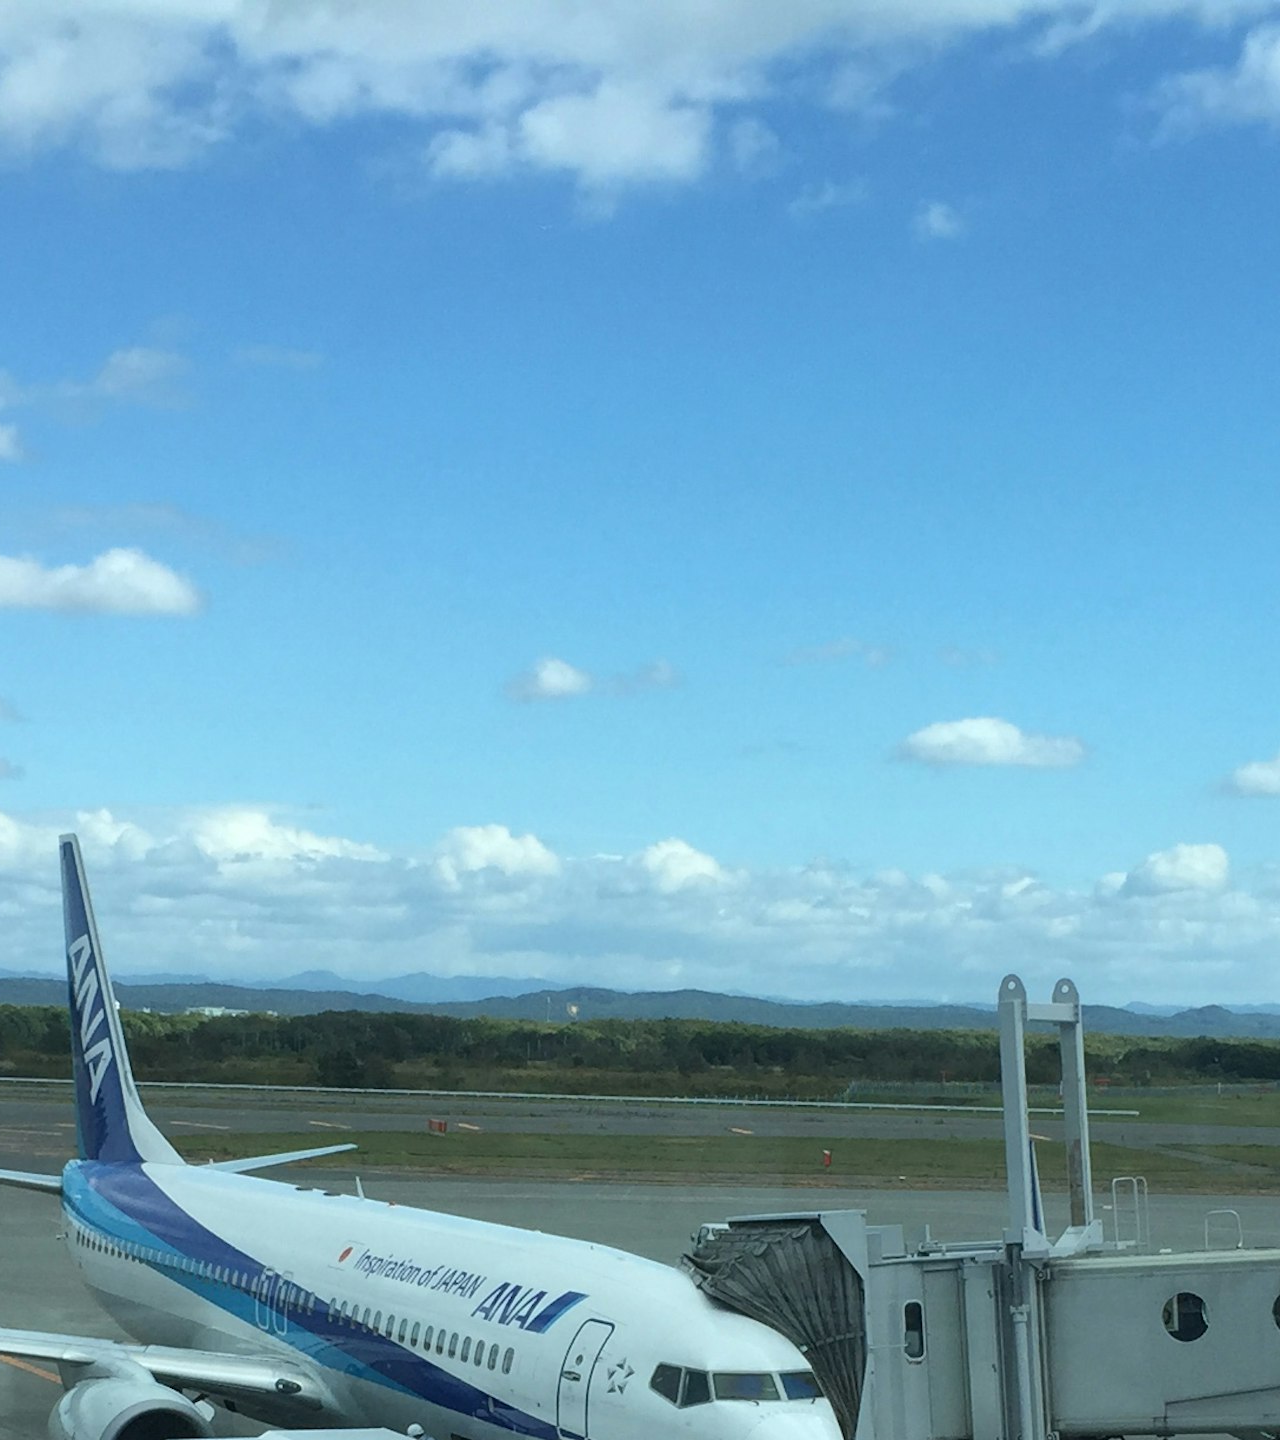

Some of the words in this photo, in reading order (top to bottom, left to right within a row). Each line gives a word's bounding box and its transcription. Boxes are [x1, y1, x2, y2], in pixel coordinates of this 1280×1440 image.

[69, 934, 112, 1106] ANA
[354, 1249, 421, 1284] Inspiration
[423, 1265, 444, 1287] of
[431, 1266, 487, 1299] JAPAN
[470, 1281, 548, 1330] ANA
